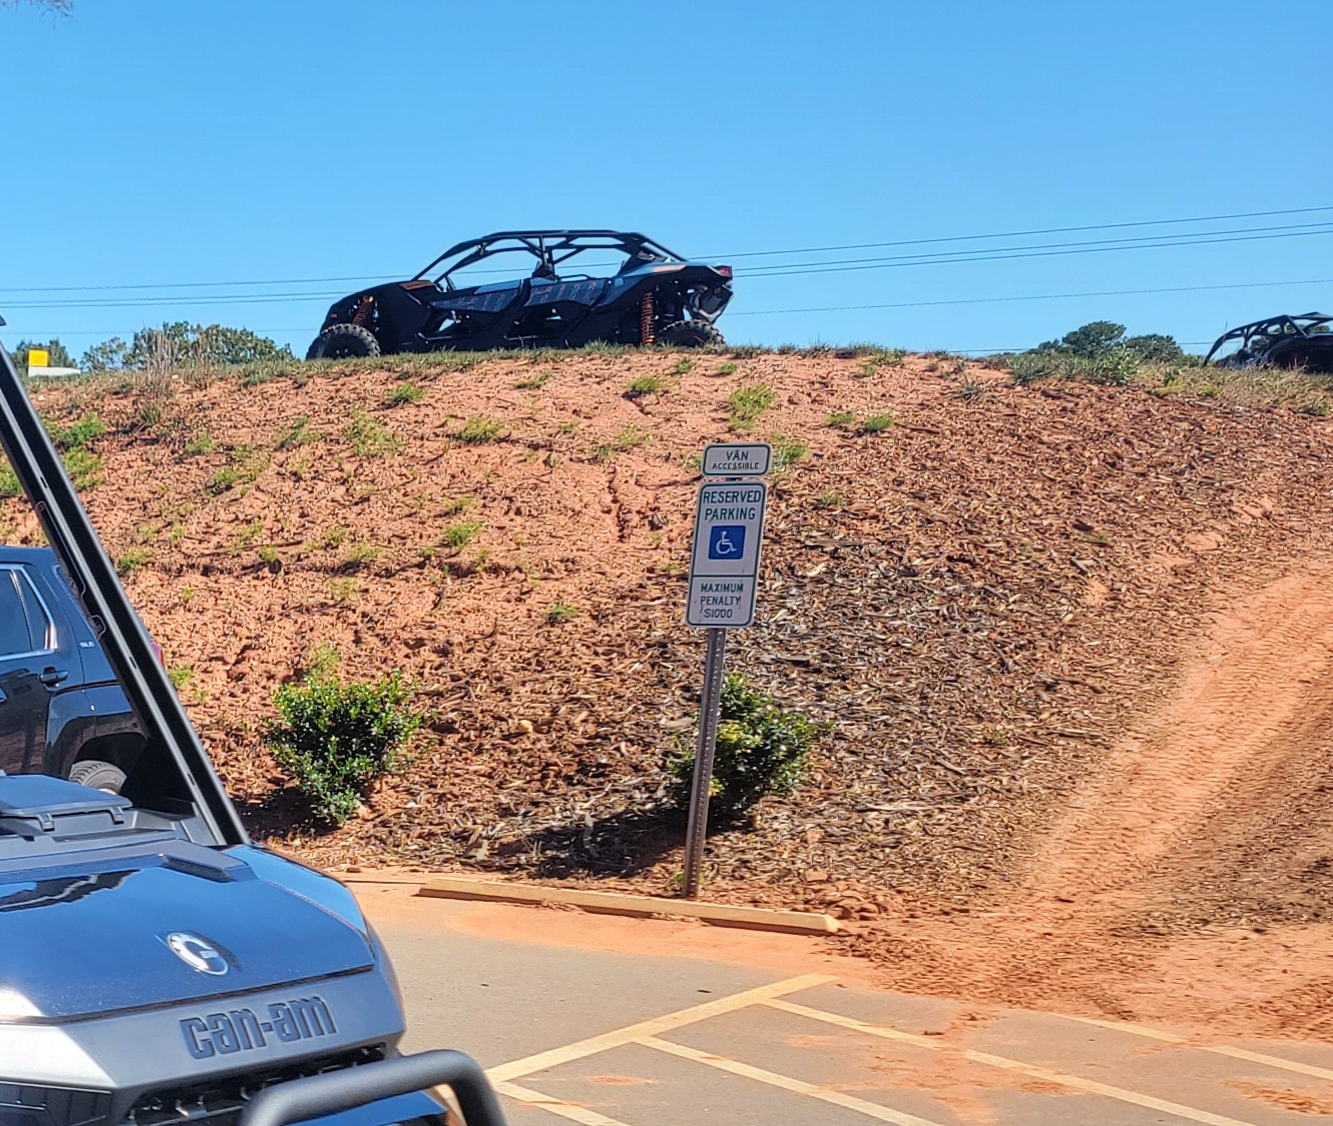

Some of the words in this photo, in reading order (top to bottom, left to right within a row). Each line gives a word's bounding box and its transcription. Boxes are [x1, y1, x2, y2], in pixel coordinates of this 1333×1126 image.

[726, 450, 749, 461] VAN
[712, 462, 760, 470] ACCESSIBLE
[703, 490, 762, 504] RESERVED
[704, 507, 756, 521] PARKING
[700, 583, 744, 593] MAXIMUM
[700, 595, 742, 606] PENALTY
